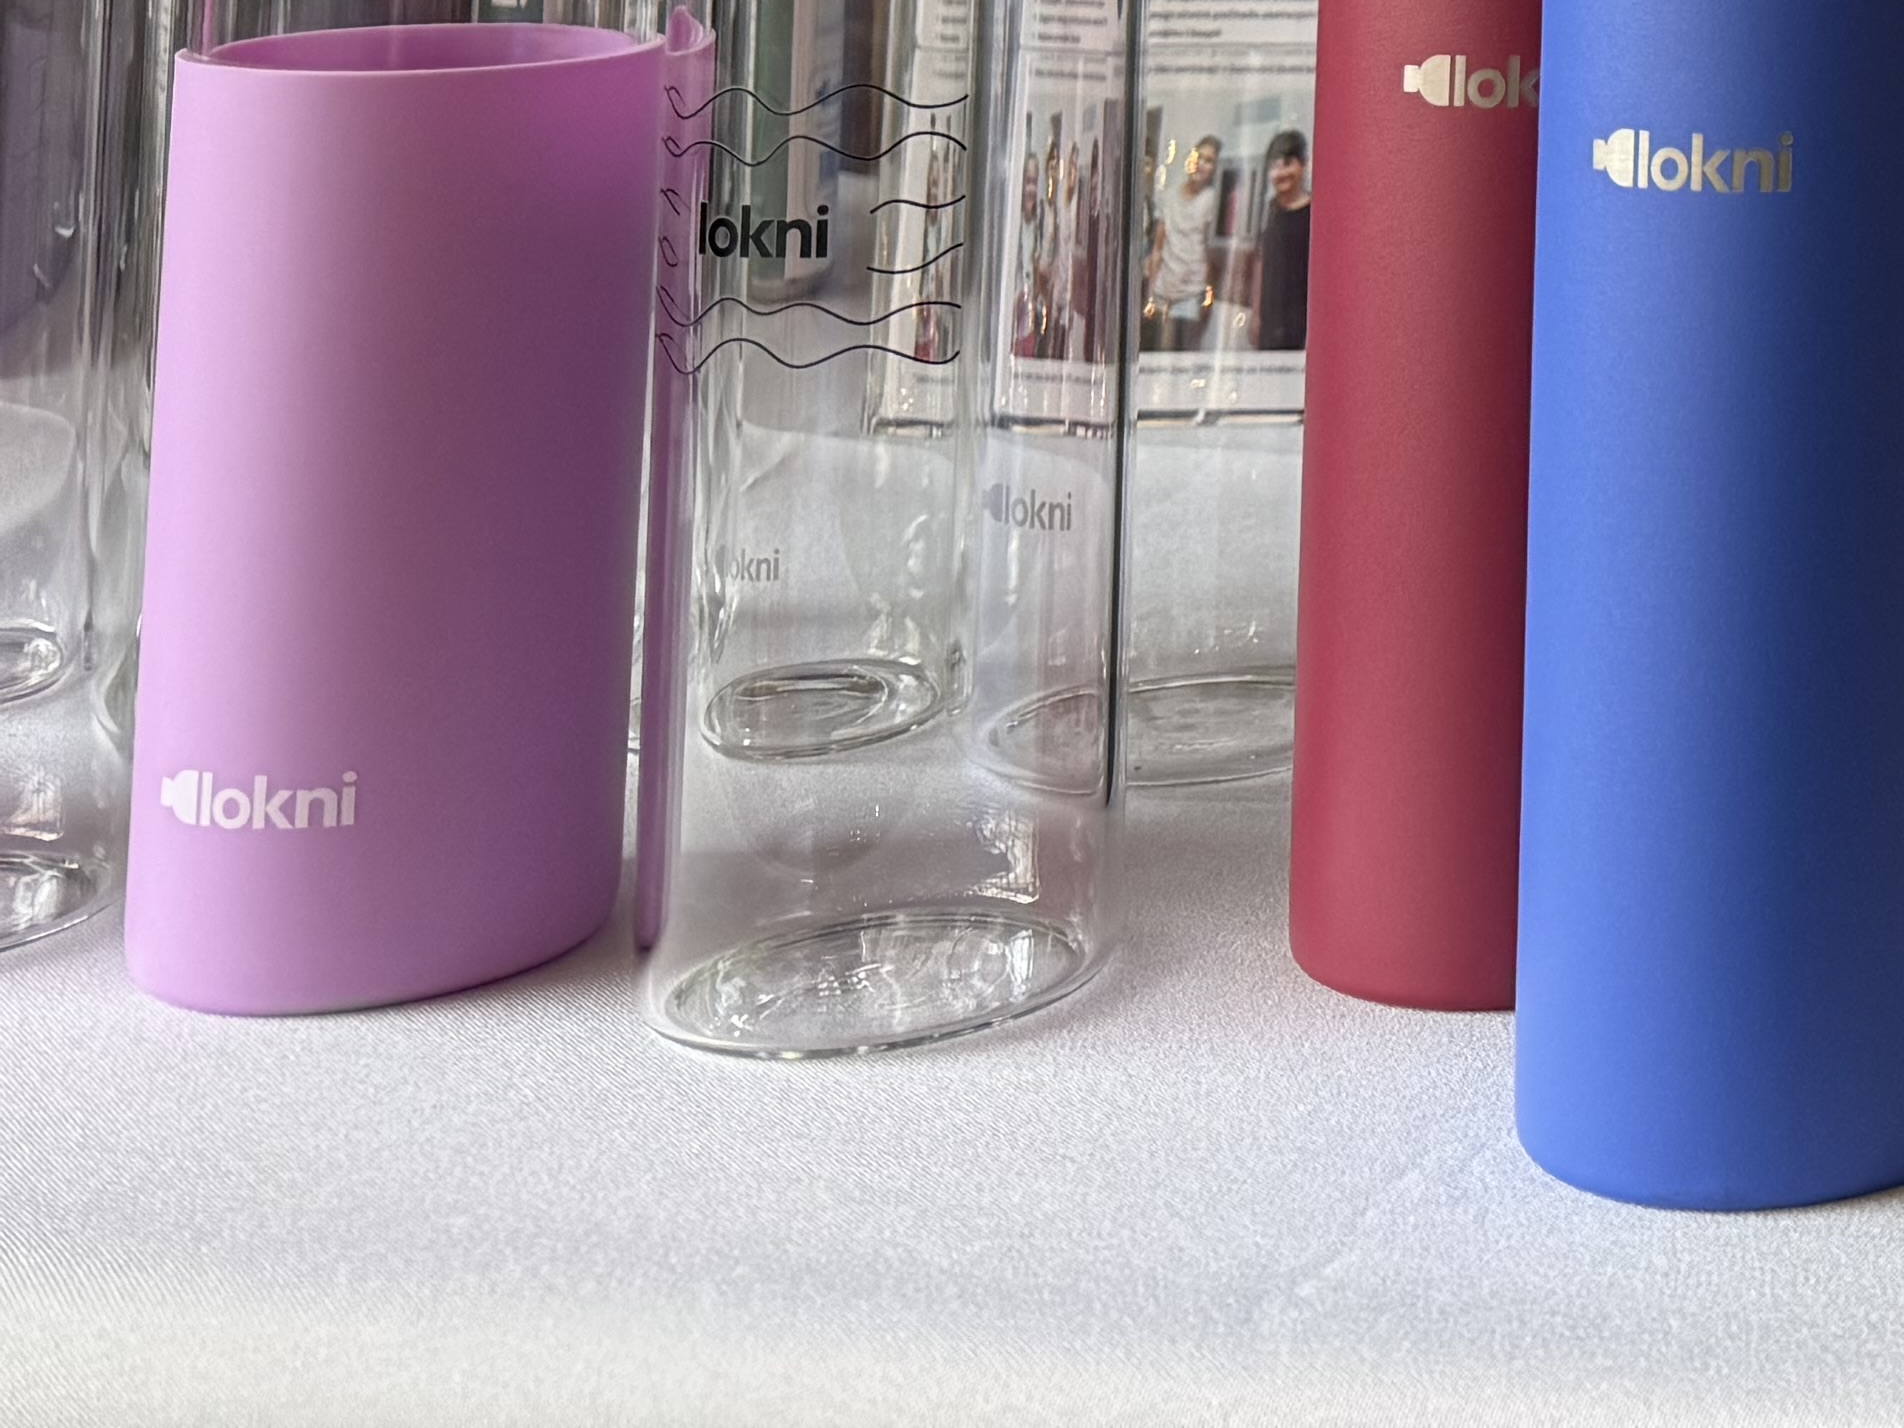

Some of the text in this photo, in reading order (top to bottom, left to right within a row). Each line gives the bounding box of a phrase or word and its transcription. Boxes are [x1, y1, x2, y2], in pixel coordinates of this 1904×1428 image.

[1637, 129, 1794, 193] lokni
[699, 201, 829, 260] lokni
[1004, 484, 1072, 531] lokni
[200, 770, 358, 830] lokni
